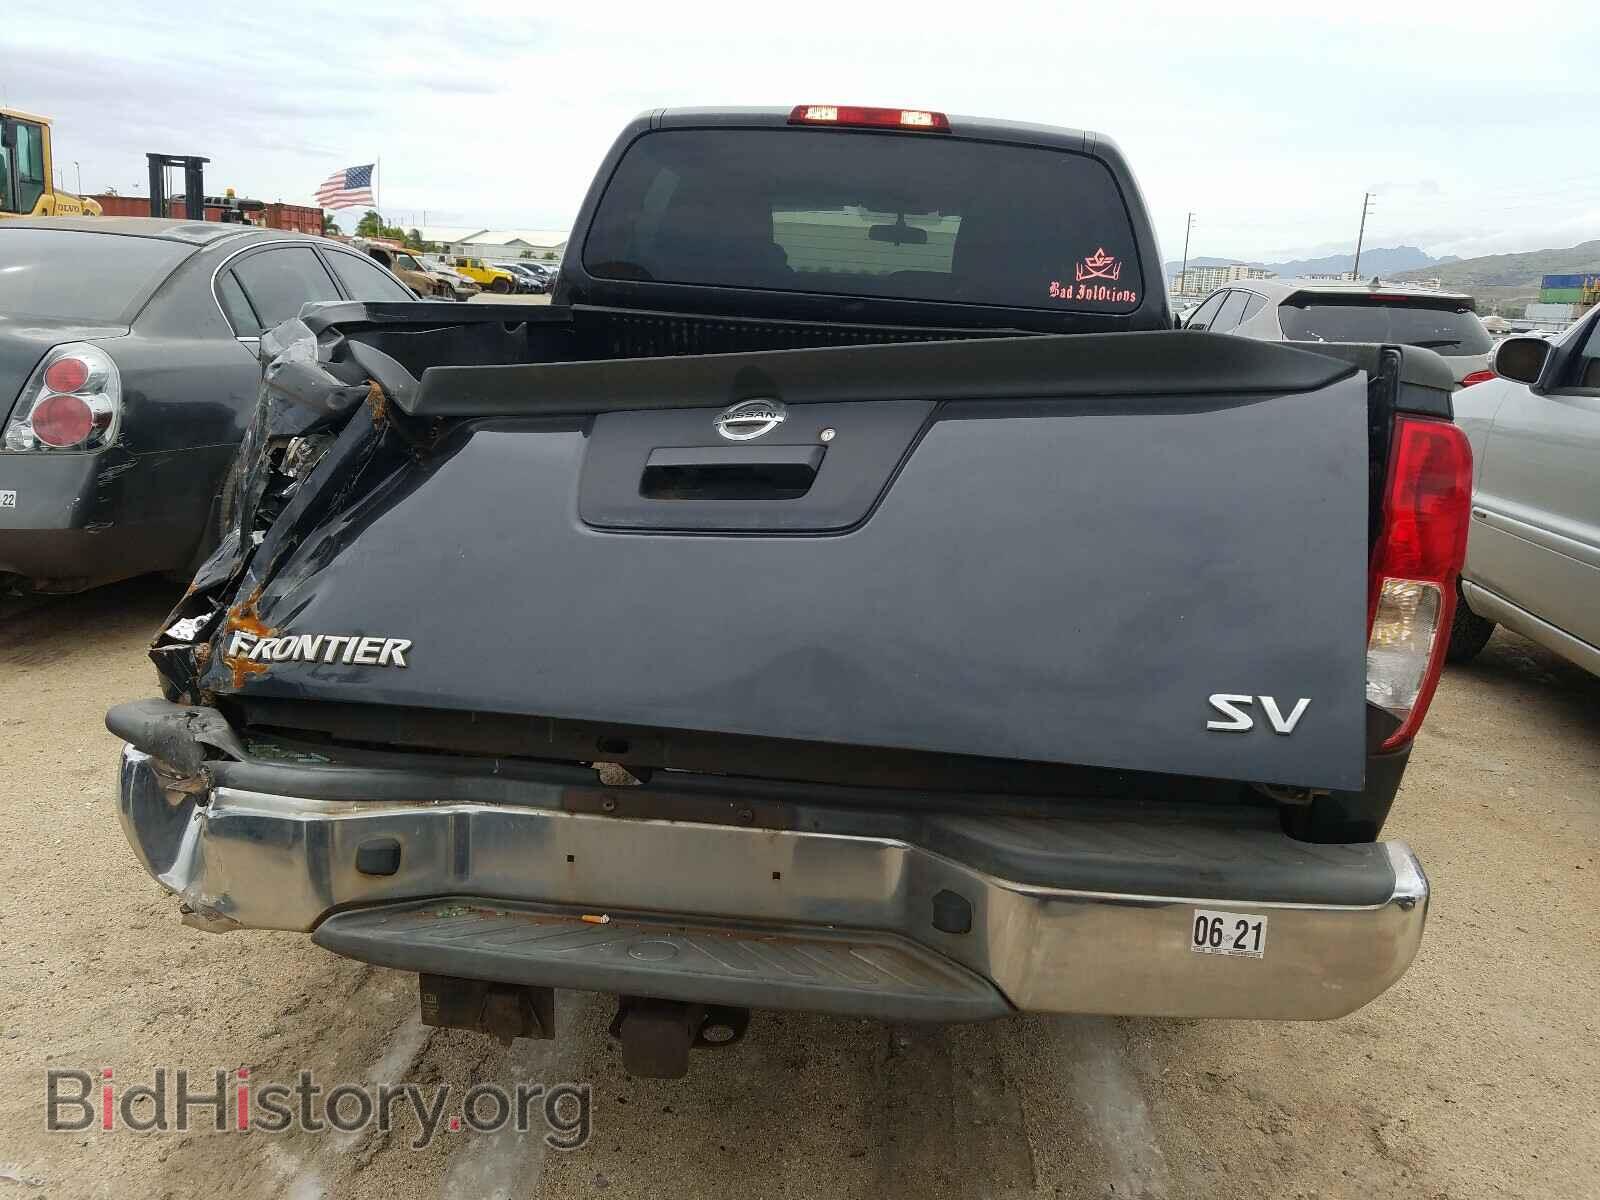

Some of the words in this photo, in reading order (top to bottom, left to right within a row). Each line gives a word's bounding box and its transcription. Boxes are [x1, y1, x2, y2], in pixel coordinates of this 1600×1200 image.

[1049, 281, 1073, 299] Bad
[721, 411, 777, 421] NISSAN
[228, 630, 412, 667] FRONTIER
[1206, 693, 1312, 735] SV
[1193, 915, 1224, 948] 06
[1232, 919, 1262, 951] 21
